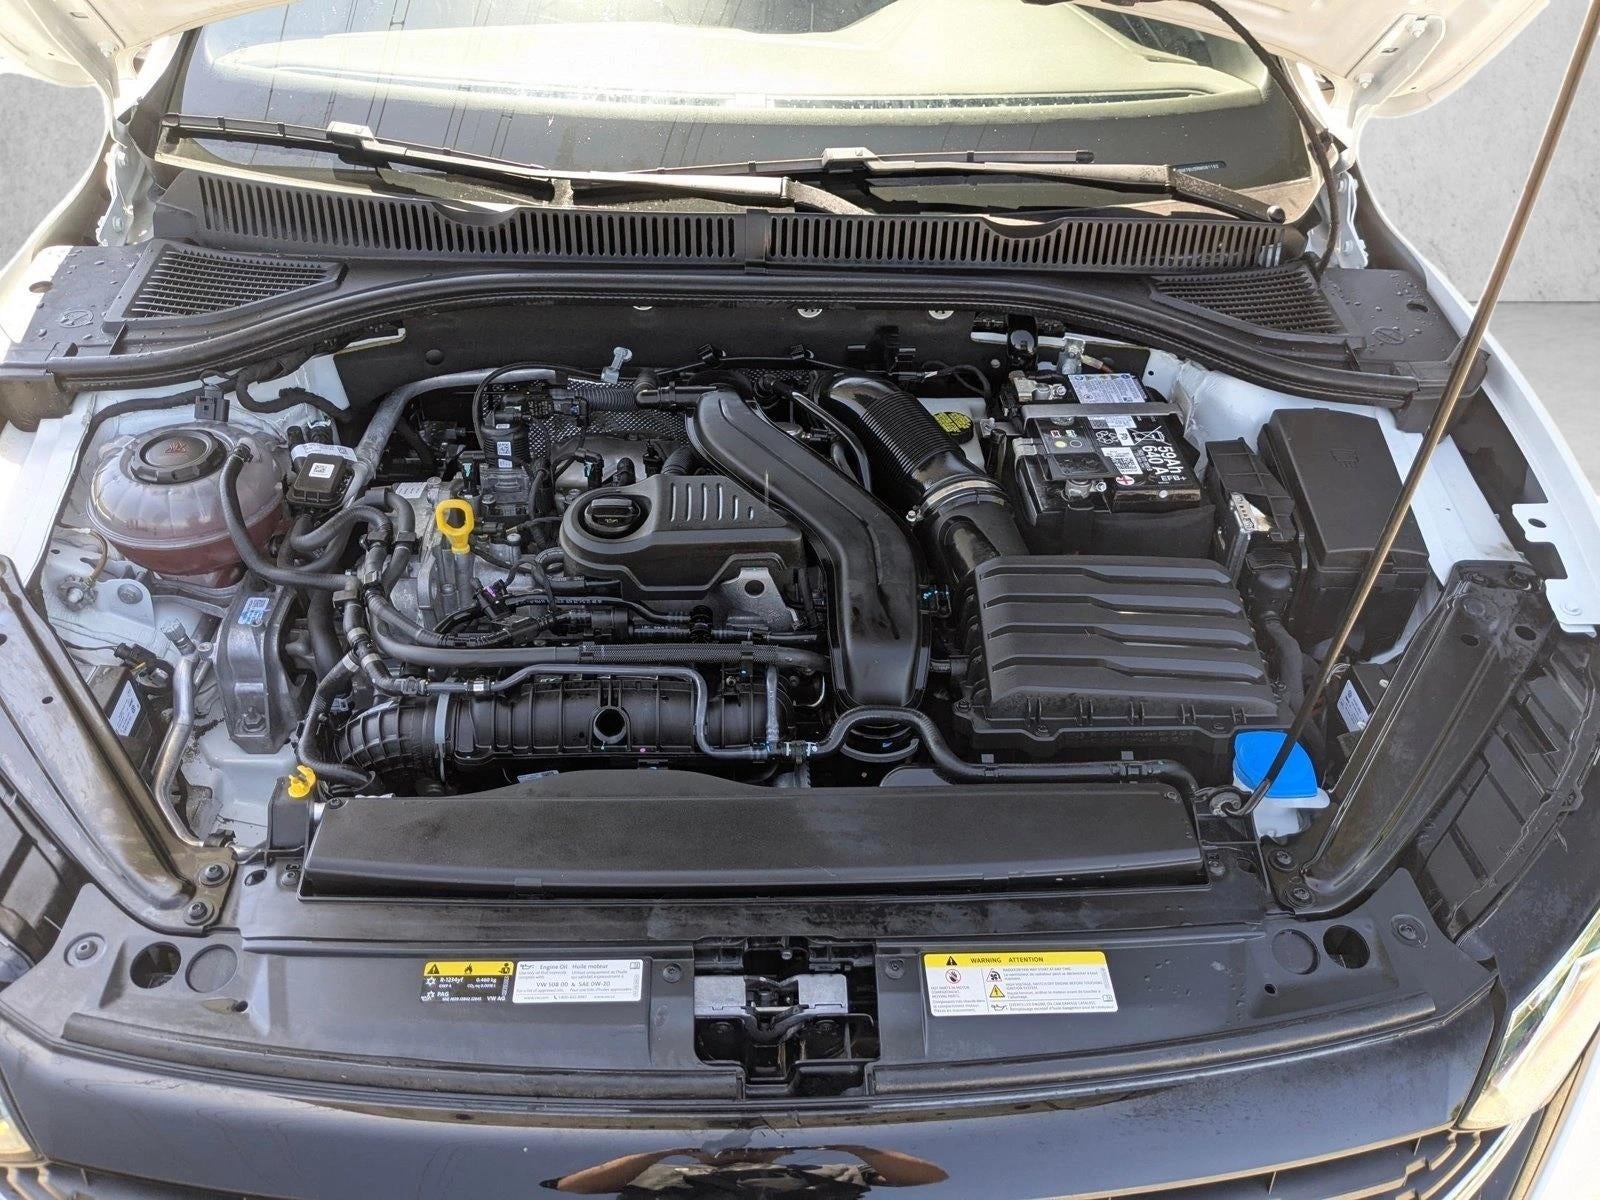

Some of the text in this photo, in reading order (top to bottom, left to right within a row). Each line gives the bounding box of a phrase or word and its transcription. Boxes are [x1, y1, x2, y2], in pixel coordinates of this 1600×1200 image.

[1142, 445, 1164, 464] 640
[1158, 446, 1184, 474] 59Ah
[1152, 466, 1170, 475] A
